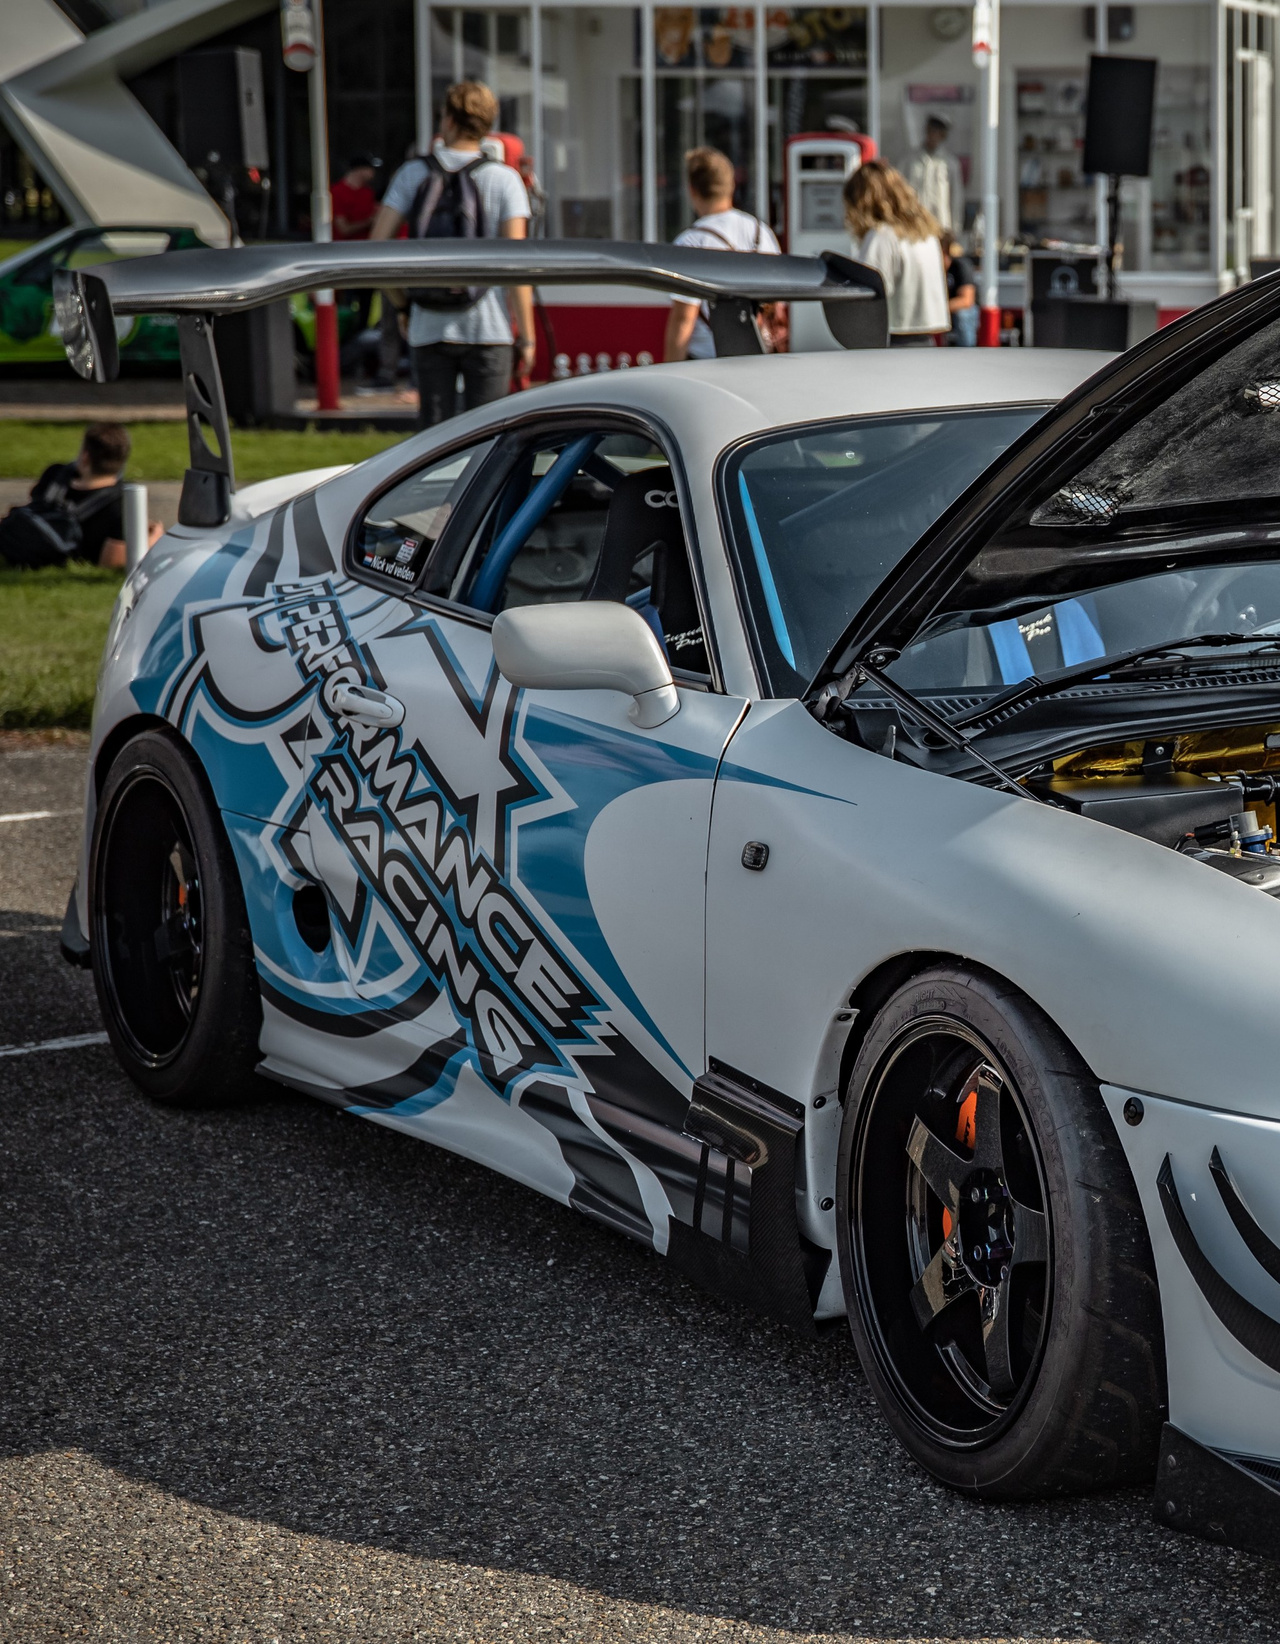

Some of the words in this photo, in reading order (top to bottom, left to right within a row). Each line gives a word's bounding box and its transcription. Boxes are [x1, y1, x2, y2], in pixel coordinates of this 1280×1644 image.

[370, 555, 386, 571] Nick
[394, 565, 415, 582] velden
[286, 600, 581, 1028] PERFORMANCE
[317, 763, 536, 1076] RACING
